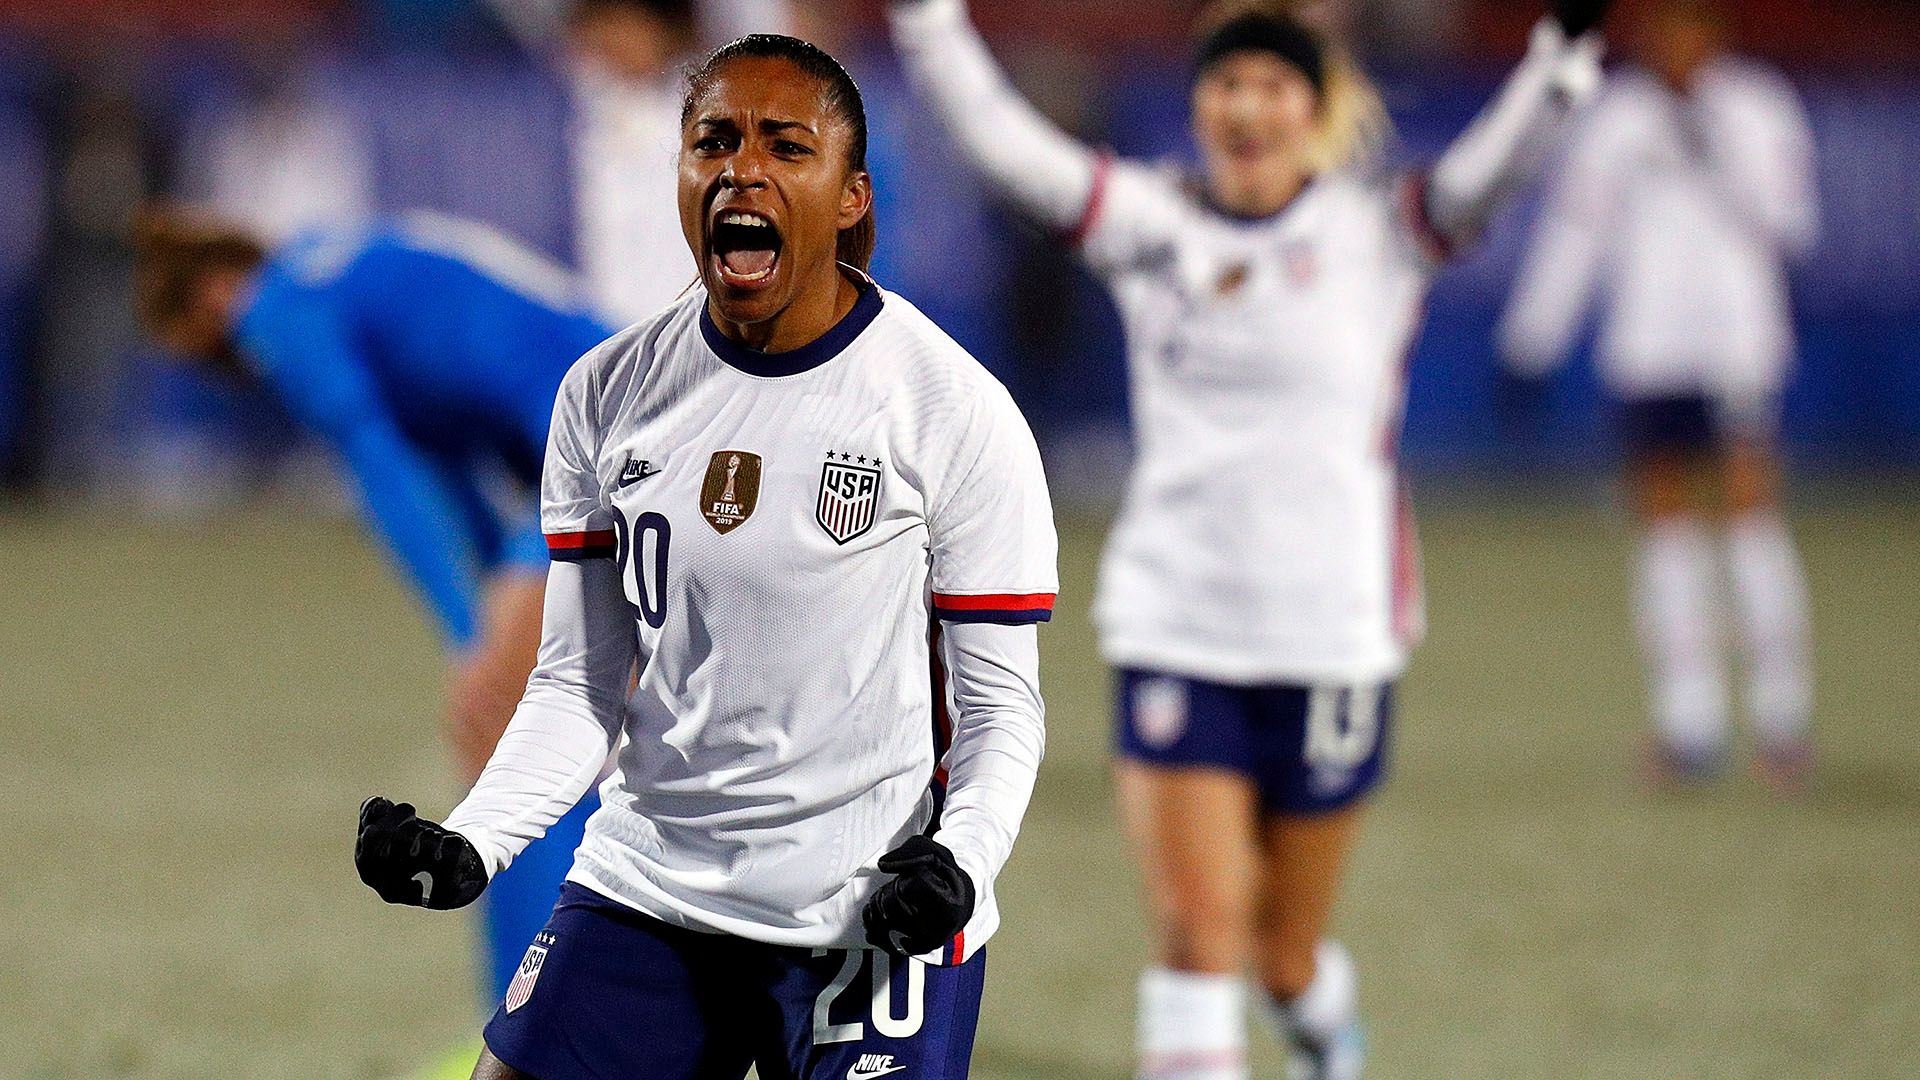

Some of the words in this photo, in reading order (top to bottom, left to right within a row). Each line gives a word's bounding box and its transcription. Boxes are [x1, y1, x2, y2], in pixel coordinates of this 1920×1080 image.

[621, 458, 651, 476] NIKE
[826, 469, 875, 500] USA
[712, 502, 740, 515] FIFA
[715, 517, 733, 525] 2019
[521, 948, 545, 975] USA
[811, 948, 925, 1045] 20
[855, 1053, 895, 1071] NIKE
